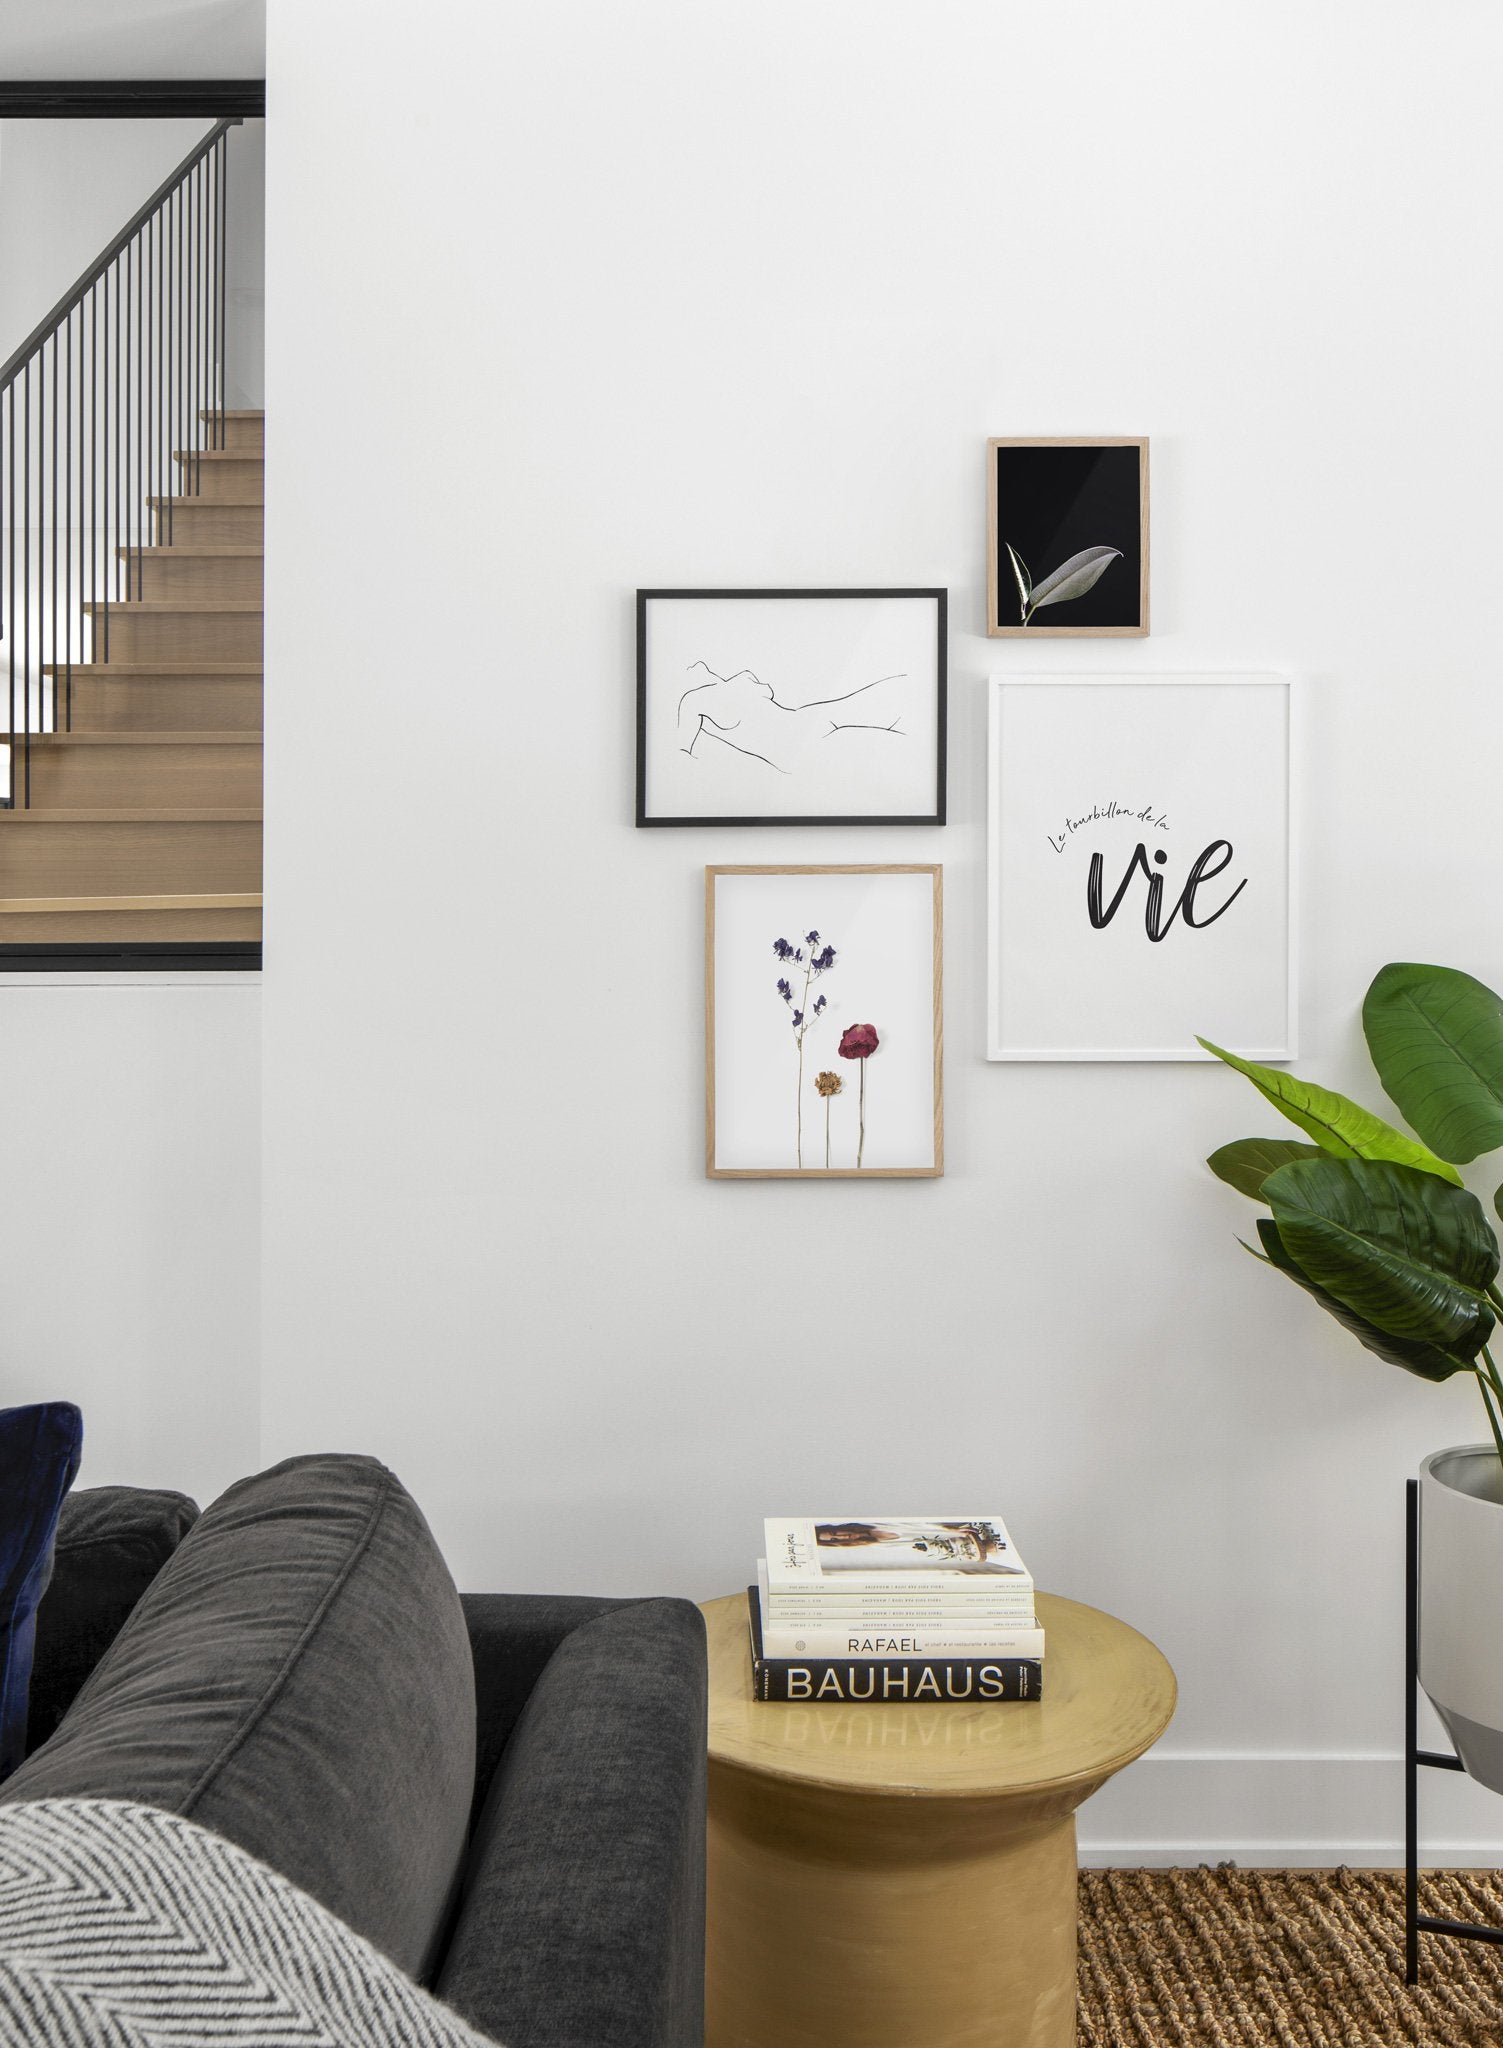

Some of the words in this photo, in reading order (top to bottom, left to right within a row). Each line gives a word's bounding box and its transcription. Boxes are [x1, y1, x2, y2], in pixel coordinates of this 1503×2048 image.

[1047, 833, 1066, 854] Le
[1065, 801, 1135, 834] tourbillon
[1136, 806, 1156, 822] de
[1153, 814, 1170, 831] la
[1087, 839, 1249, 943] vie
[848, 1638, 923, 1652] RAFAEL
[787, 1665, 1005, 1699] BAUHAUS
